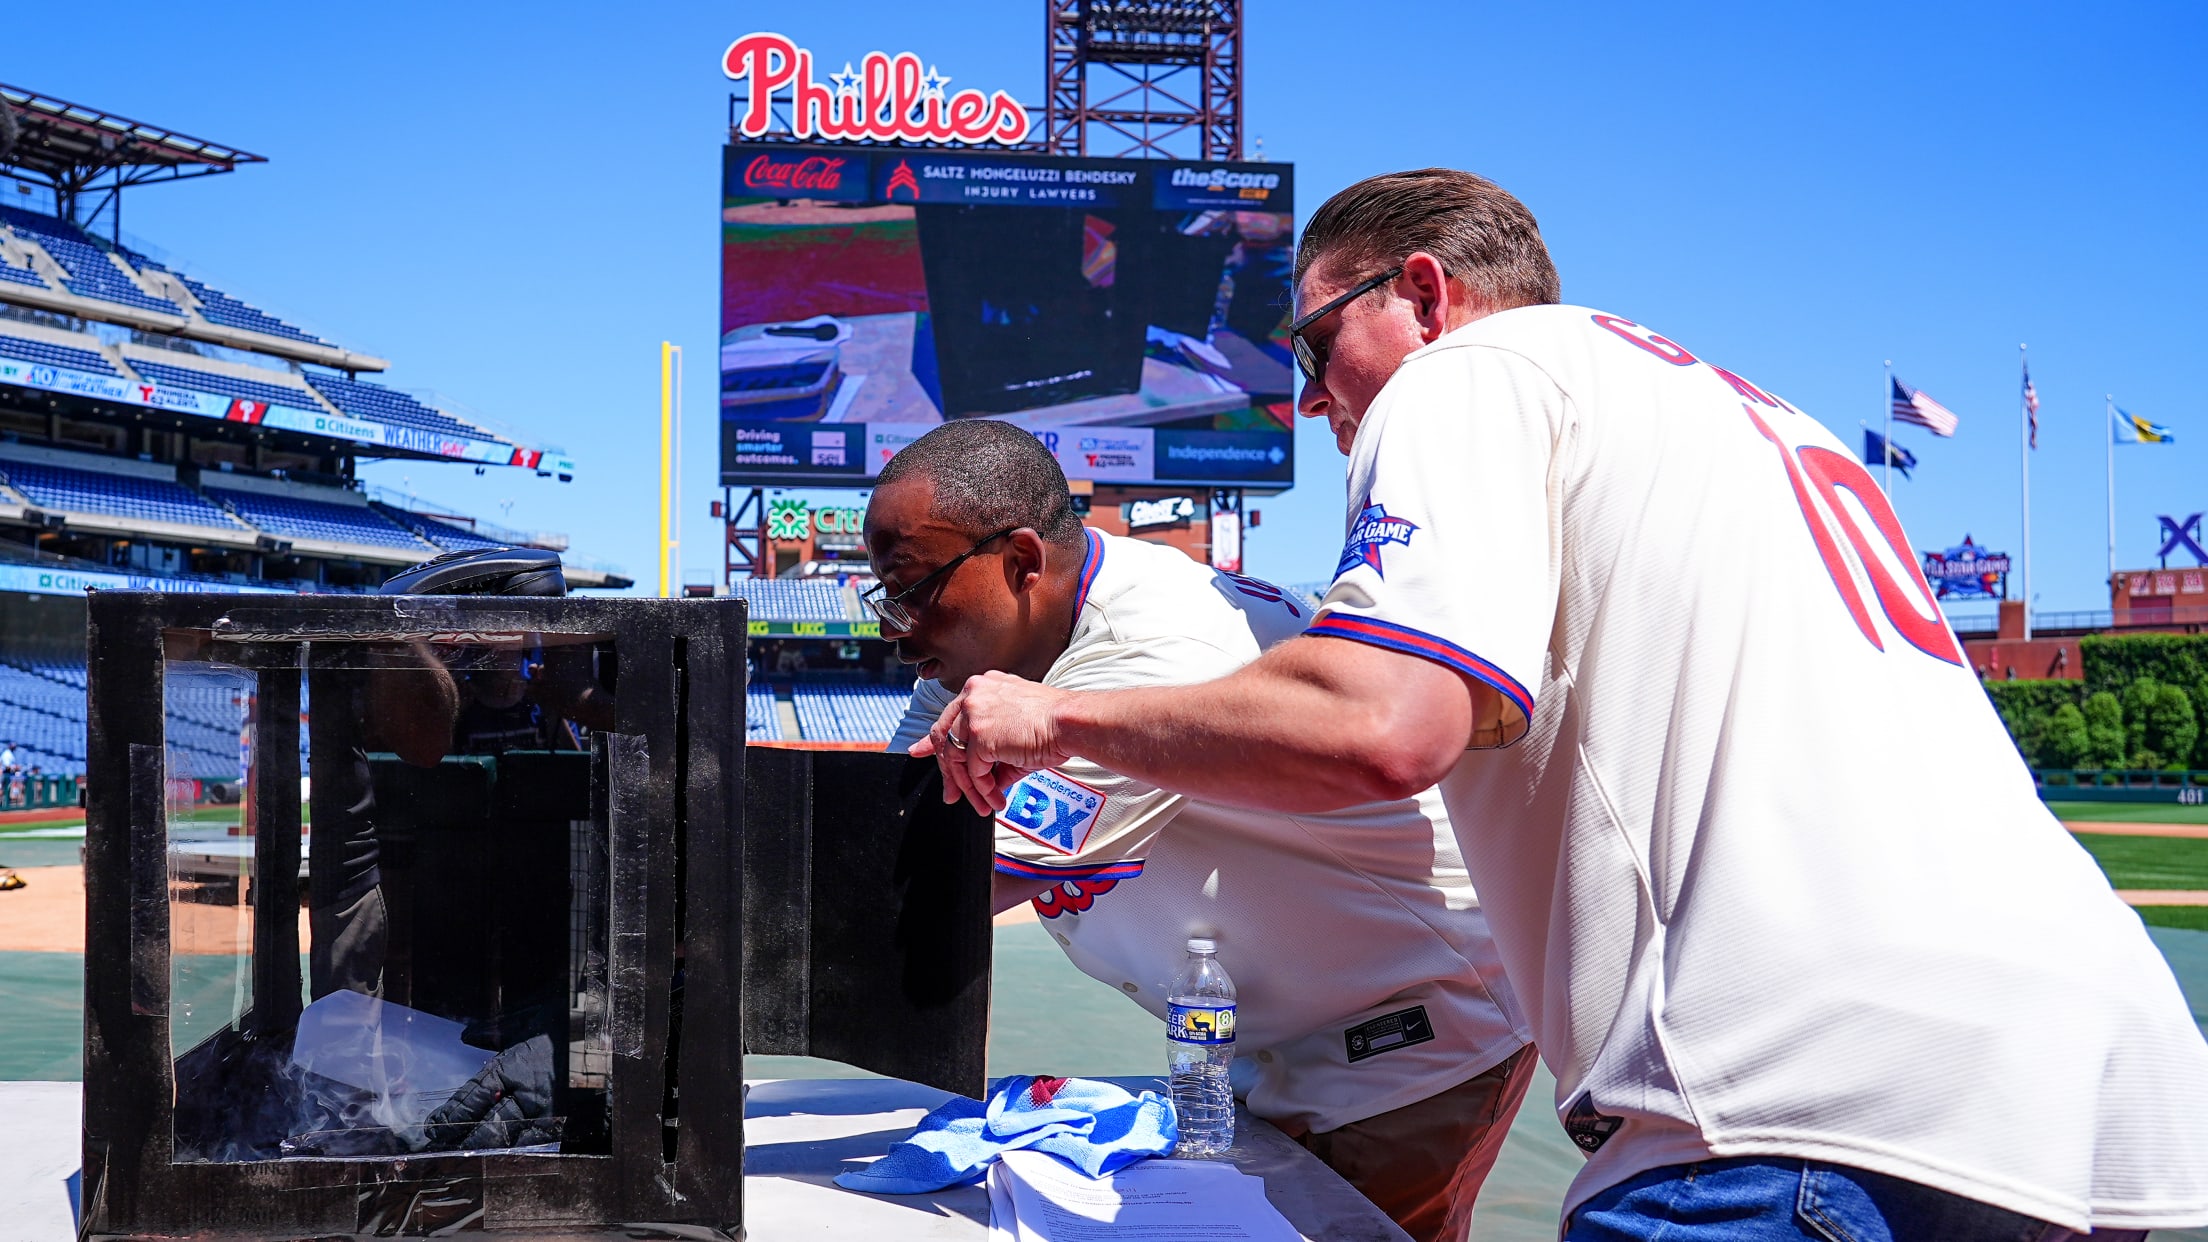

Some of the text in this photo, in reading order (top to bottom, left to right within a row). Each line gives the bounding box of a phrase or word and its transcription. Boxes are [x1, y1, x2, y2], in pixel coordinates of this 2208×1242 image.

[722, 32, 1030, 144] Phillies
[923, 164, 1136, 185] SALTZ MONGELUZZI BENDESKY
[1172, 168, 1280, 189] theScore
[965, 185, 1096, 200] INJURY LAWYERS
[327, 419, 375, 439] Citizens
[736, 429, 780, 443] Driving
[383, 424, 442, 453] WEATHER
[736, 442, 784, 453] smarter
[1168, 445, 1264, 462] Independence
[1364, 521, 1410, 542] GAME
[1742, 403, 1966, 668] 10
[748, 621, 769, 636] KG
[792, 621, 826, 636] UKG
[1029, 771, 1083, 802] pendence
[2177, 788, 2203, 805] 401
[1003, 781, 1091, 850] BX
[1167, 1012, 1186, 1027] EER
[1167, 1025, 1188, 1039] ARK
